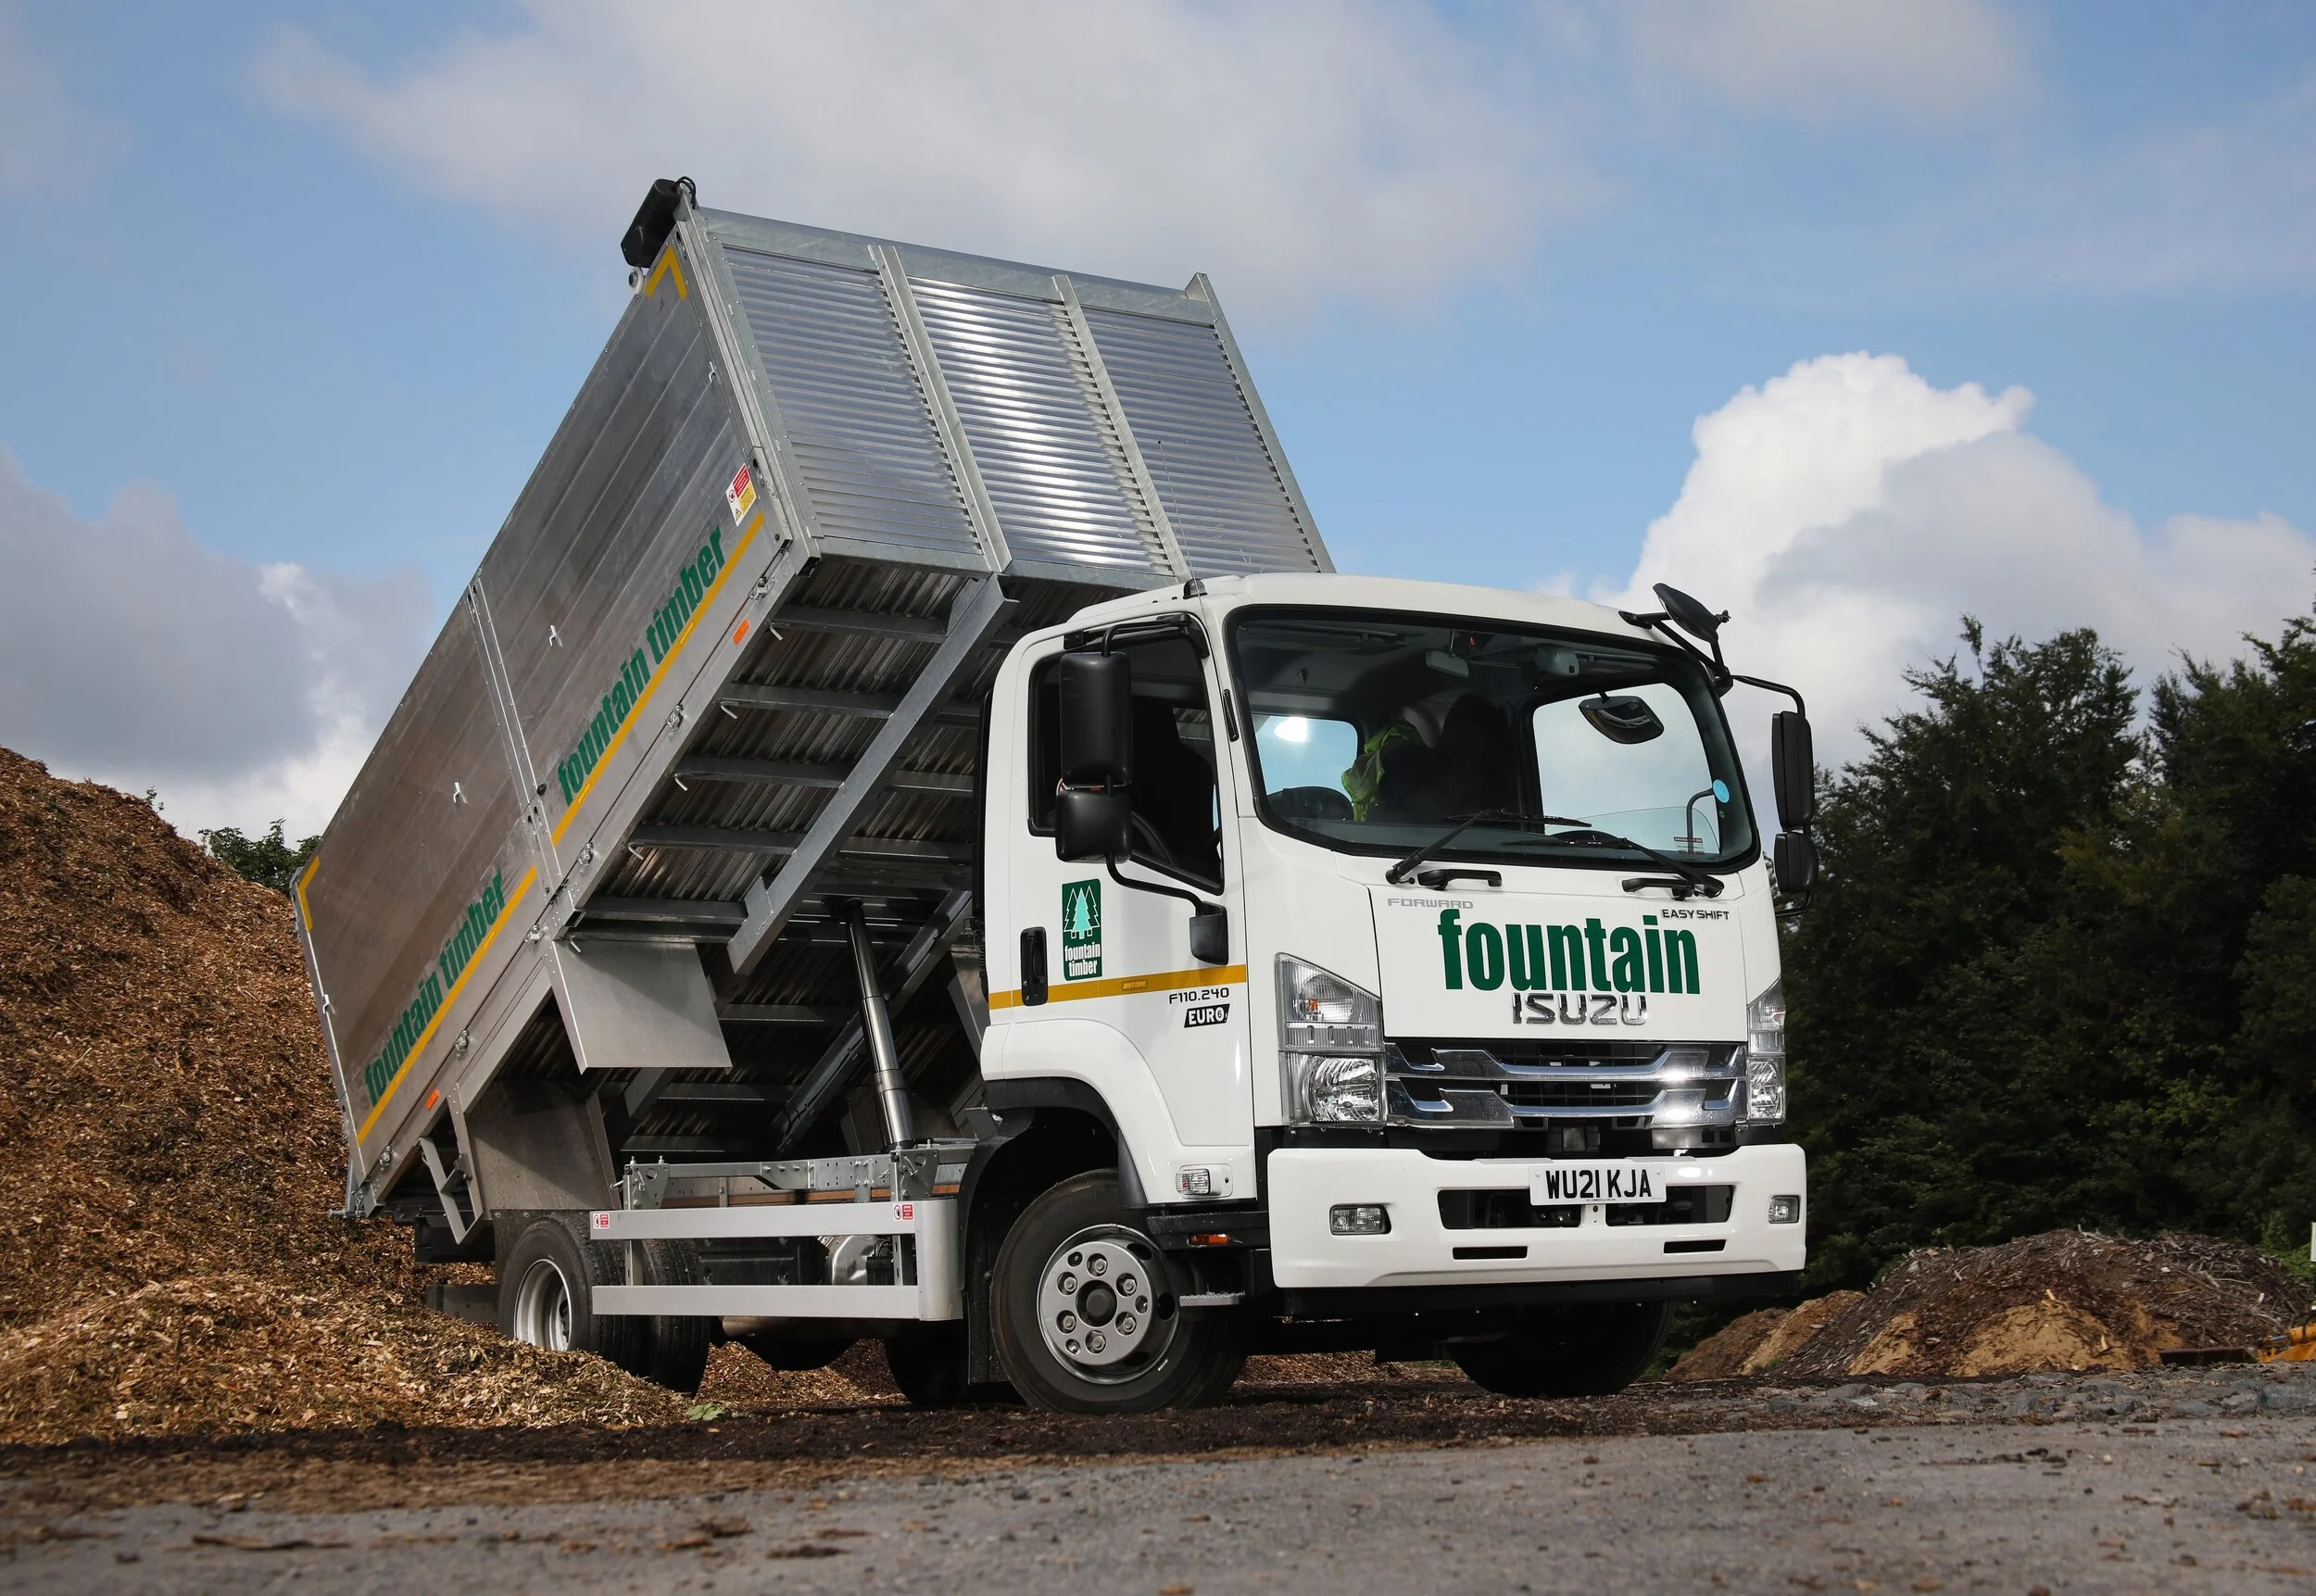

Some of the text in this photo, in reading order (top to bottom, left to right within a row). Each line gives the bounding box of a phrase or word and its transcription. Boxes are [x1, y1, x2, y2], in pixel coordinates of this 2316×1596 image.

[558, 525, 725, 807] fountain timber
[1387, 898, 1474, 909] FORWARD
[1662, 909, 1730, 921] EASY SHIFT
[1064, 941, 1101, 961] fountain
[1437, 908, 1701, 995] fountain
[1068, 959, 1098, 977] timber
[365, 869, 505, 1107] fountain timber
[1168, 987, 1229, 1004] F110.240
[1512, 992, 1647, 1026] ISUZU
[1545, 1168, 1653, 1199] WU21 KJA
